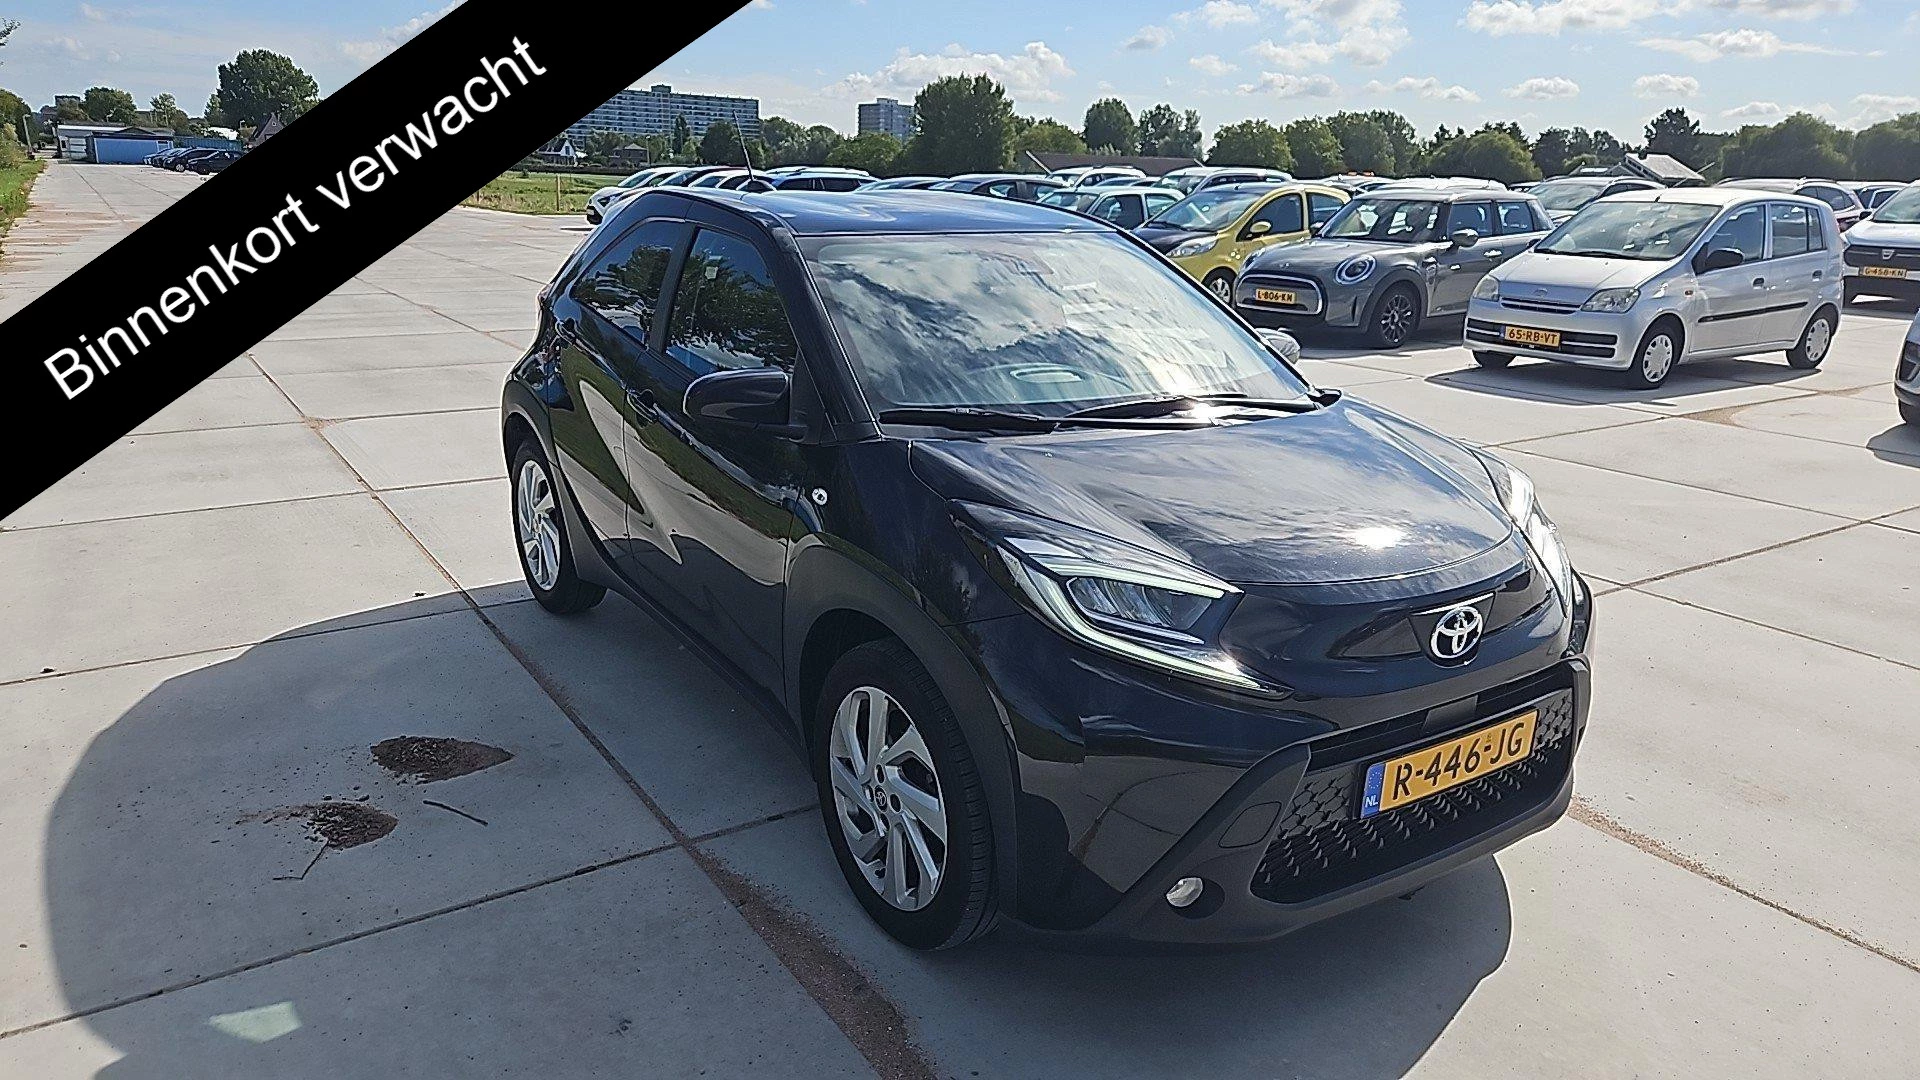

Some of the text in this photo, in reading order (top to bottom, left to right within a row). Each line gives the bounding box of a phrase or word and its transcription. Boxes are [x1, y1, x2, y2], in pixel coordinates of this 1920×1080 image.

[1257, 290, 1293, 301] L-806-KN
[1508, 328, 1558, 344] 65-RB-VT
[1392, 722, 1525, 801] R-446-JG
[1365, 794, 1379, 808] NL
